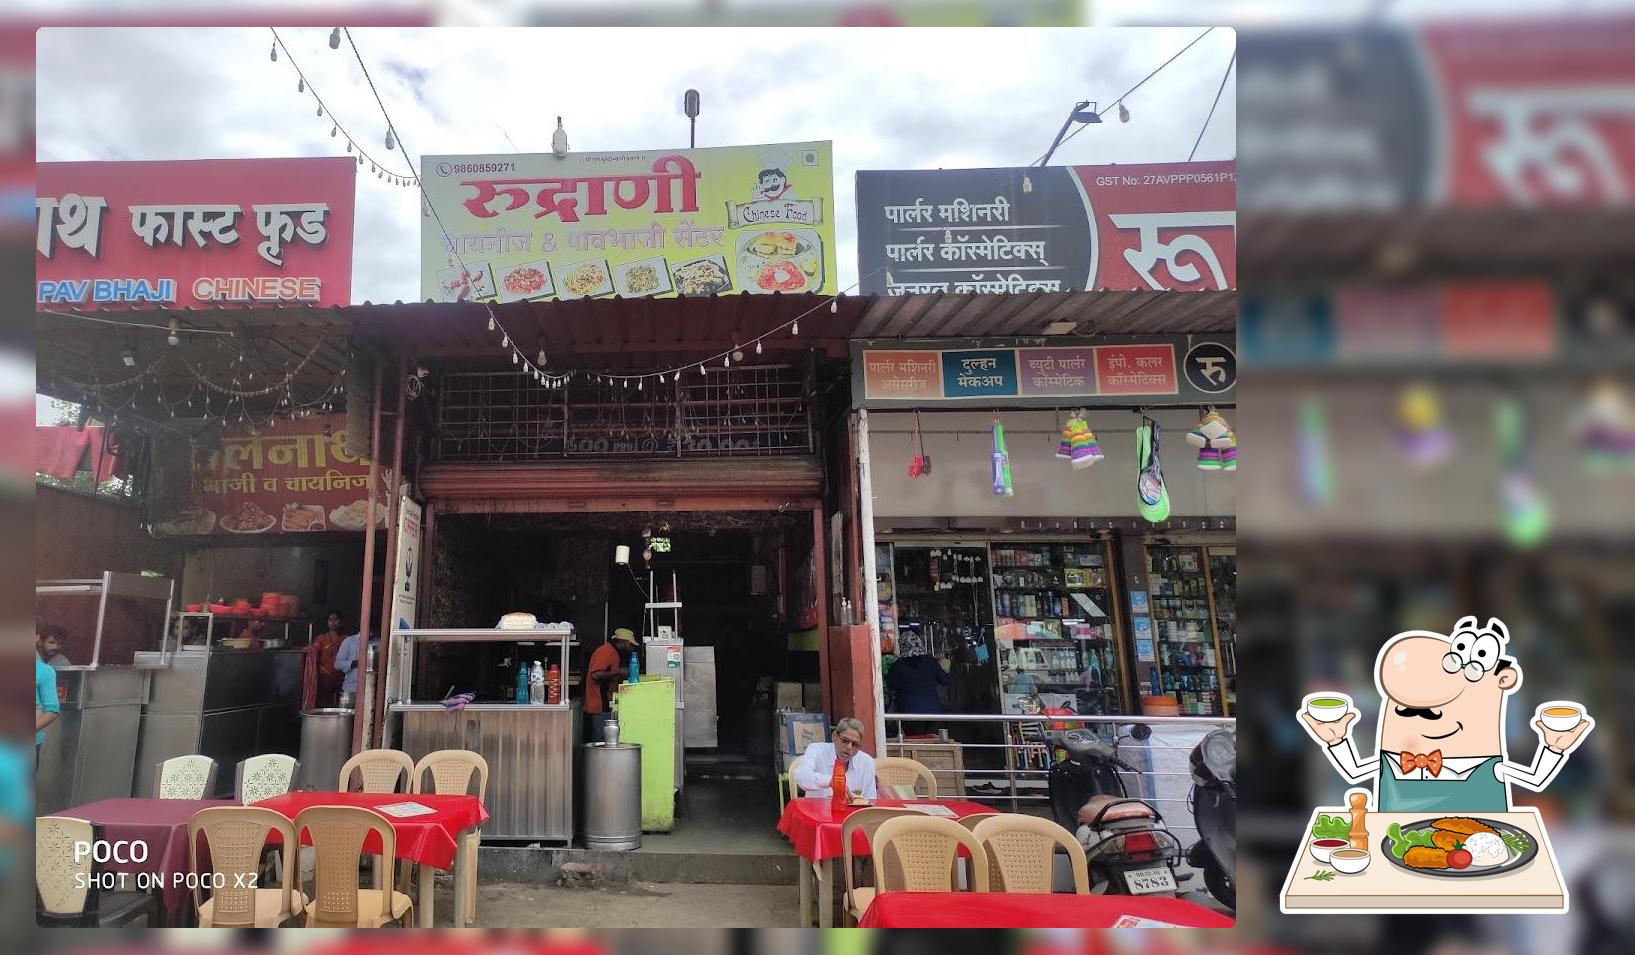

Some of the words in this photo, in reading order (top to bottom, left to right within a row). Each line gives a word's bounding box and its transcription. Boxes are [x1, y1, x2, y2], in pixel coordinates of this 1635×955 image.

[454, 163, 516, 174] 9860859271
[460, 155, 701, 222] रुद्राणी
[1095, 176, 1120, 186] GST
[1122, 175, 1141, 186] No:
[743, 206, 780, 223] Chinese
[784, 203, 808, 221] Food
[885, 198, 934, 223] पार्लर
[938, 196, 1010, 223] मशिनरी
[128, 204, 243, 249] फास्ट
[542, 232, 559, 252] &
[886, 236, 935, 262] पार्लर
[38, 280, 90, 303] PAV
[93, 279, 177, 302] BHAJI
[192, 277, 320, 301] CHINESE
[961, 358, 997, 375] दुल्हन
[1058, 355, 1087, 370] पार्लर
[1136, 357, 1164, 369] कलर
[957, 373, 1004, 388] मेकअप
[262, 477, 278, 493] व
[1133, 876, 1169, 889] 8783
